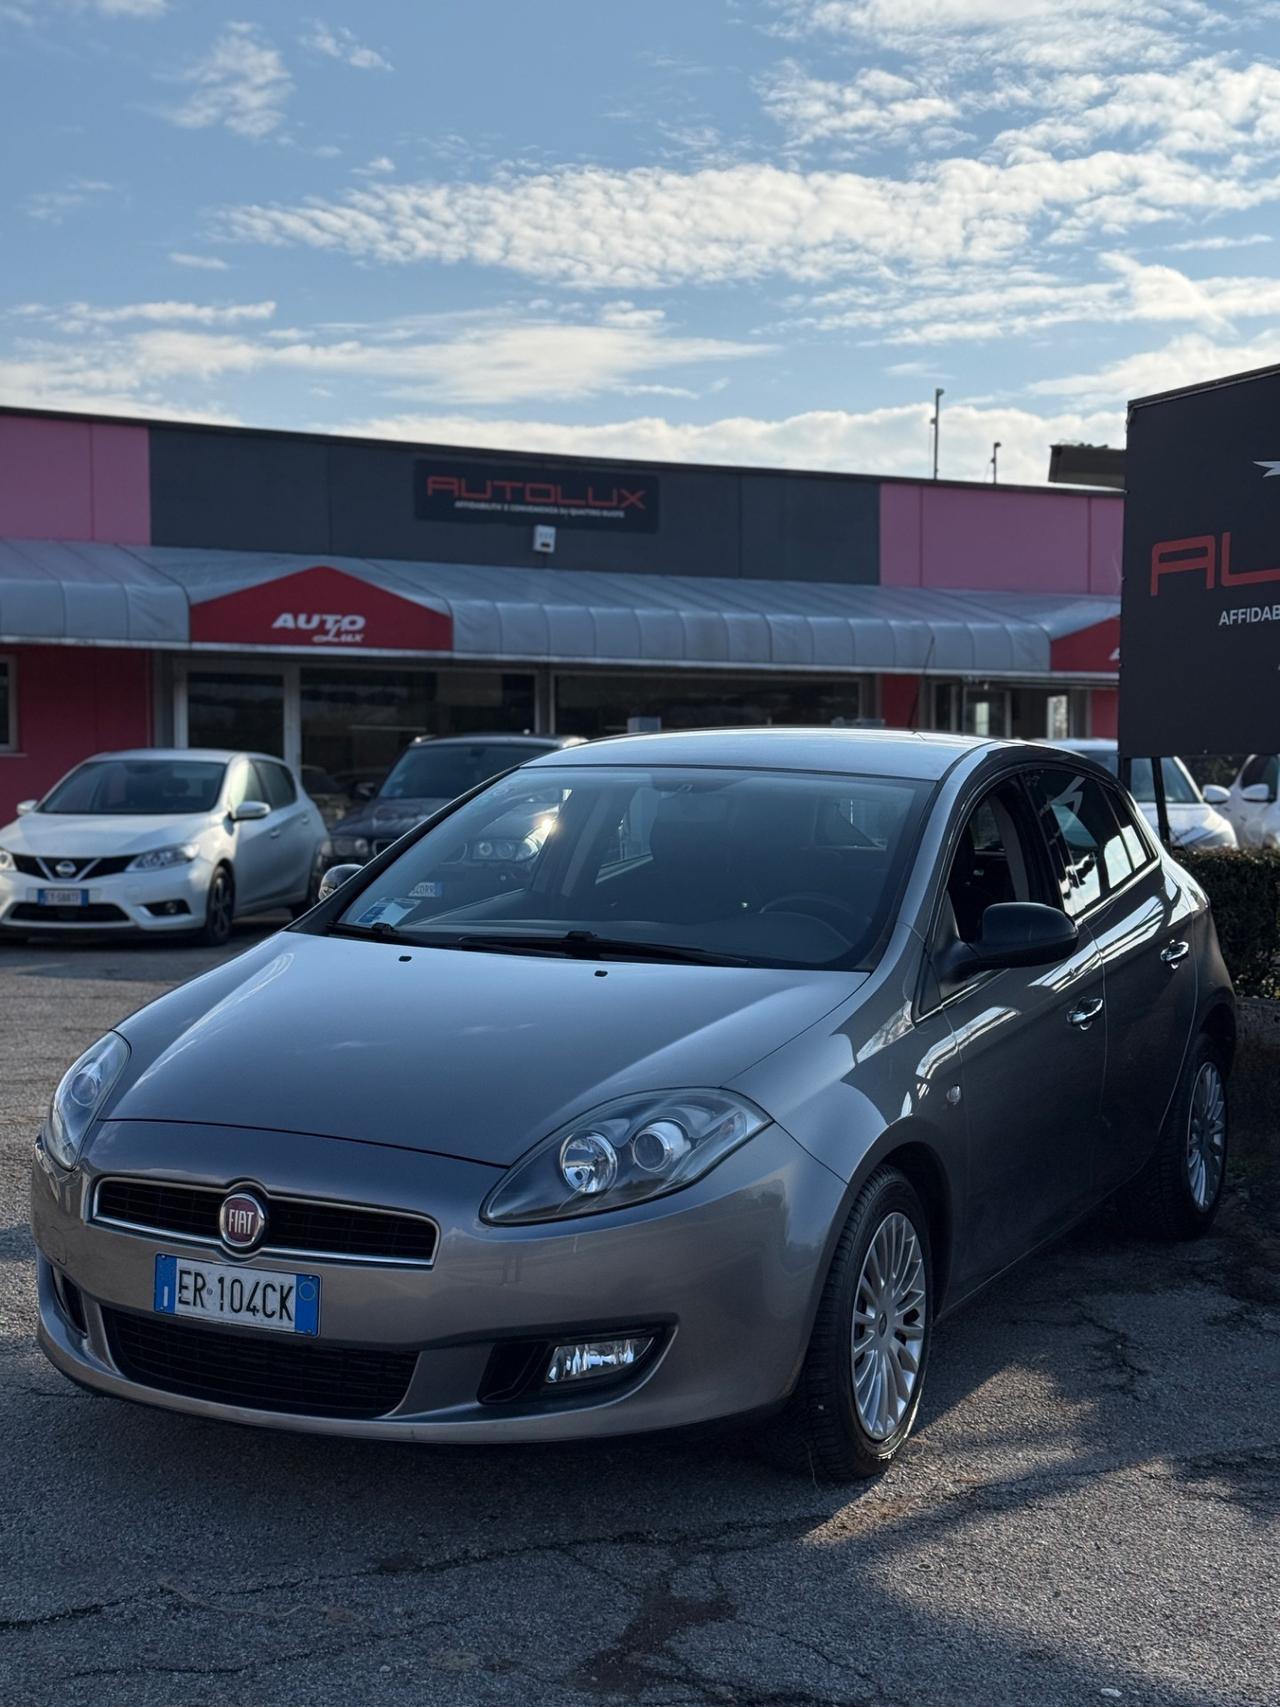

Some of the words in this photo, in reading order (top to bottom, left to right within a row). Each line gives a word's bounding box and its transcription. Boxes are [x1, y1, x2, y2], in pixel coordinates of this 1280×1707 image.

[427, 476, 646, 509] AUTOLUX
[271, 612, 366, 631] AUTO
[228, 1208, 255, 1235] FIAT
[178, 1269, 206, 1308] ER
[217, 1276, 294, 1322] 104CK
